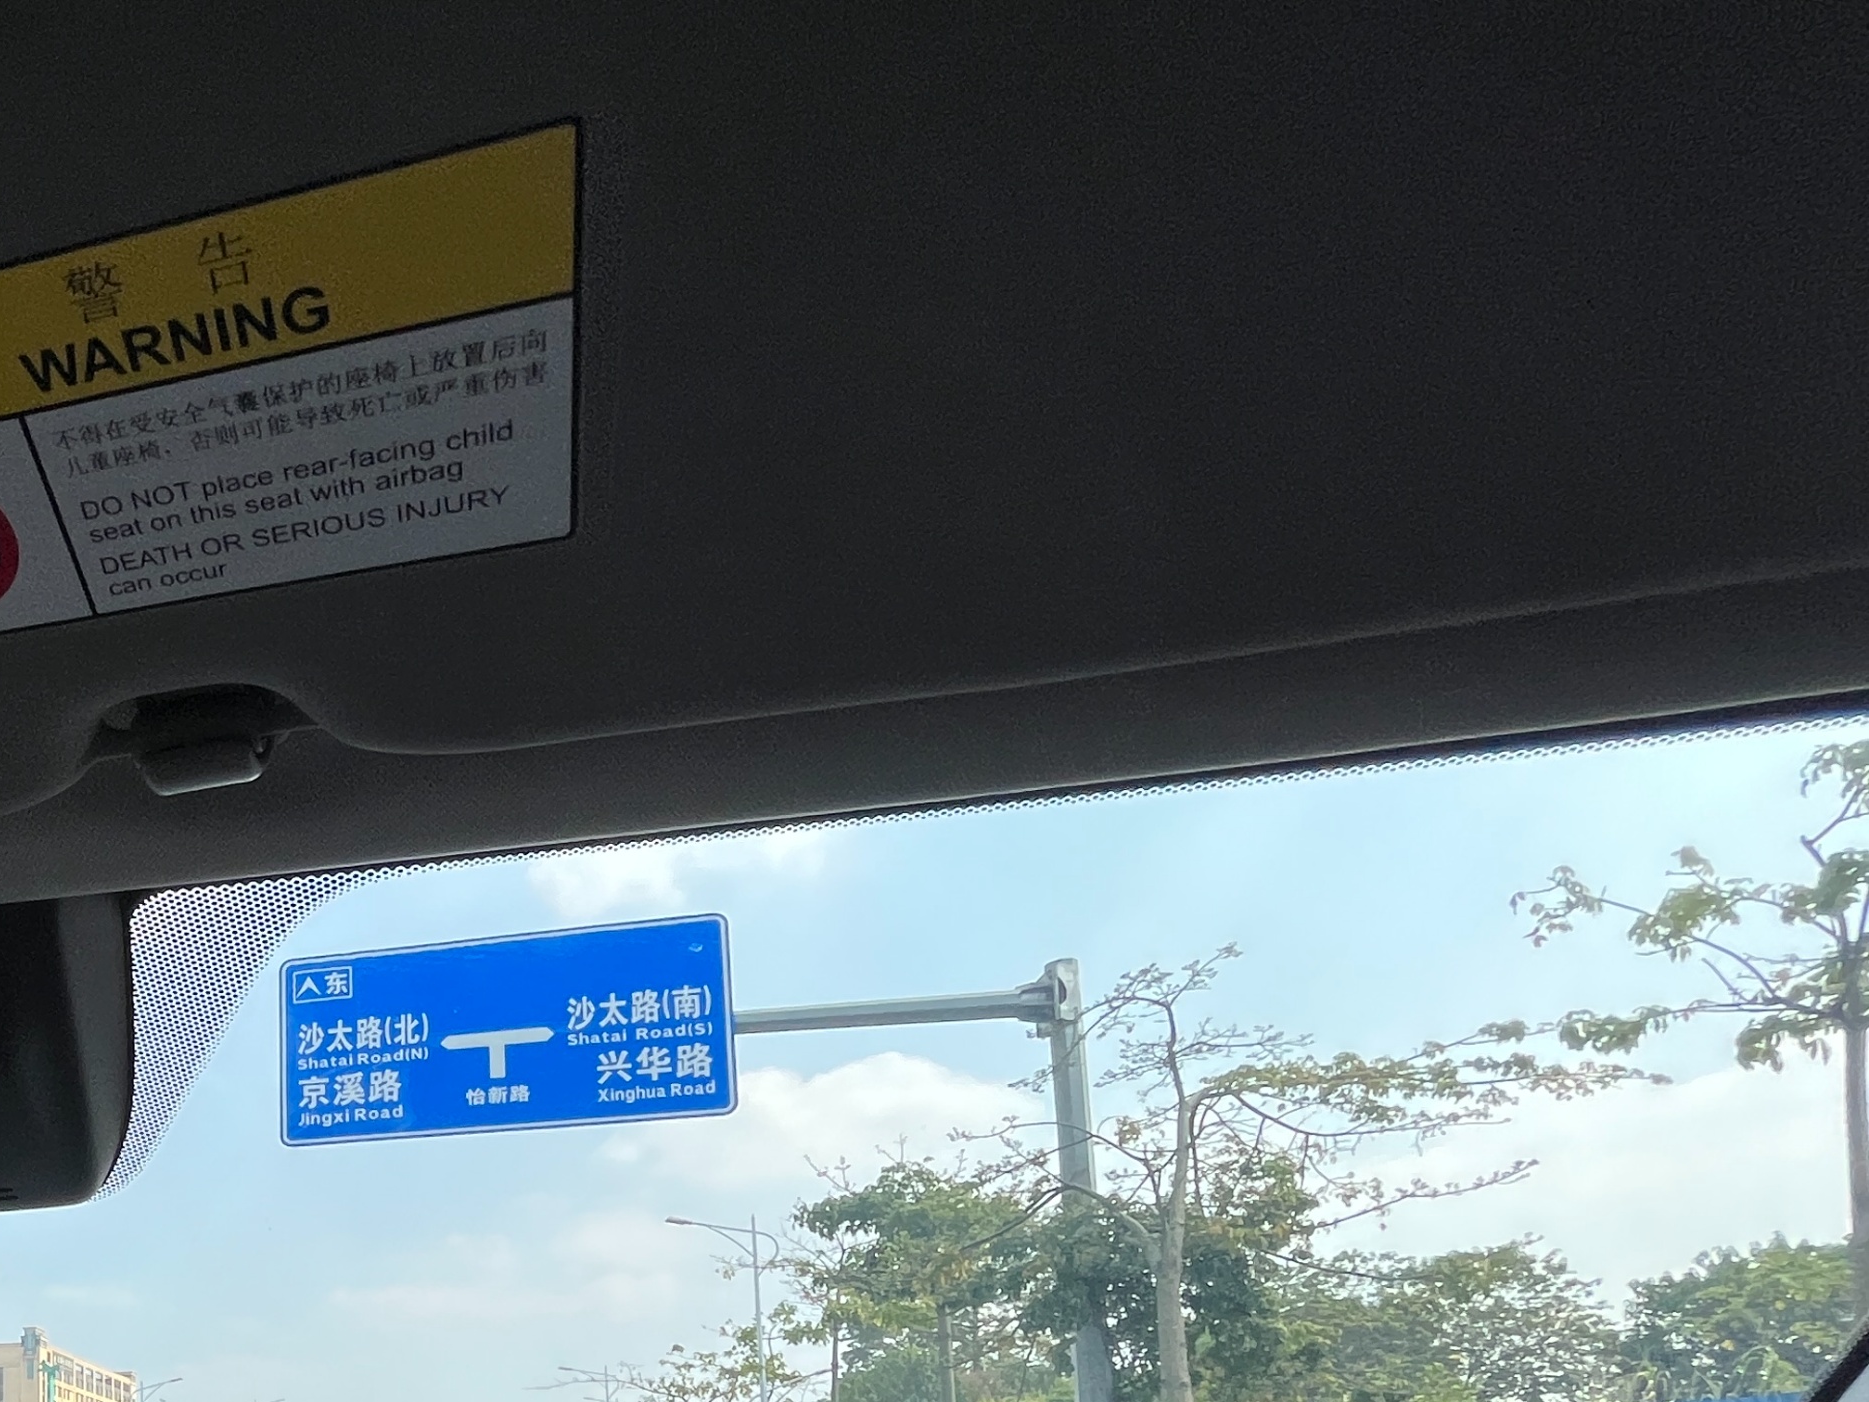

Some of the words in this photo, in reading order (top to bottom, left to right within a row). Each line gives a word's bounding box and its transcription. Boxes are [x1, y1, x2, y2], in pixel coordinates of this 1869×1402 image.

[65, 231, 253, 323] 警告
[19, 286, 330, 392] WARNING
[80, 496, 123, 521] DO
[131, 481, 192, 511] NOT
[201, 466, 274, 502] place
[283, 437, 436, 483] rear-facing
[445, 418, 514, 453] child
[89, 520, 143, 544] seat
[151, 513, 182, 533] on
[190, 500, 237, 527] this
[244, 491, 303, 515] seat
[310, 473, 366, 505] with
[375, 459, 464, 491] airbag
[100, 543, 192, 576] DEATH
[201, 534, 243, 557] OR
[253, 509, 386, 548] SERIOUS
[397, 486, 511, 524] INJURY
[108, 578, 152, 597] can
[160, 562, 228, 589] occur
[324, 970, 349, 995] 东
[567, 984, 712, 1031] 沙太路(南)
[298, 1012, 429, 1054] 沙太路(北)
[567, 1028, 627, 1046] Shatai
[635, 1021, 713, 1041] Road(S)
[298, 1053, 355, 1071] Shatai
[357, 1046, 429, 1066] Road(N)
[597, 1042, 713, 1085] 兴华路
[298, 1070, 402, 1109] 京溪路
[466, 1084, 531, 1106] 怡新路
[597, 1084, 668, 1105] Xinghua
[670, 1079, 717, 1098] Road
[298, 1107, 352, 1128] Jingxi
[354, 1105, 404, 1122] Road
